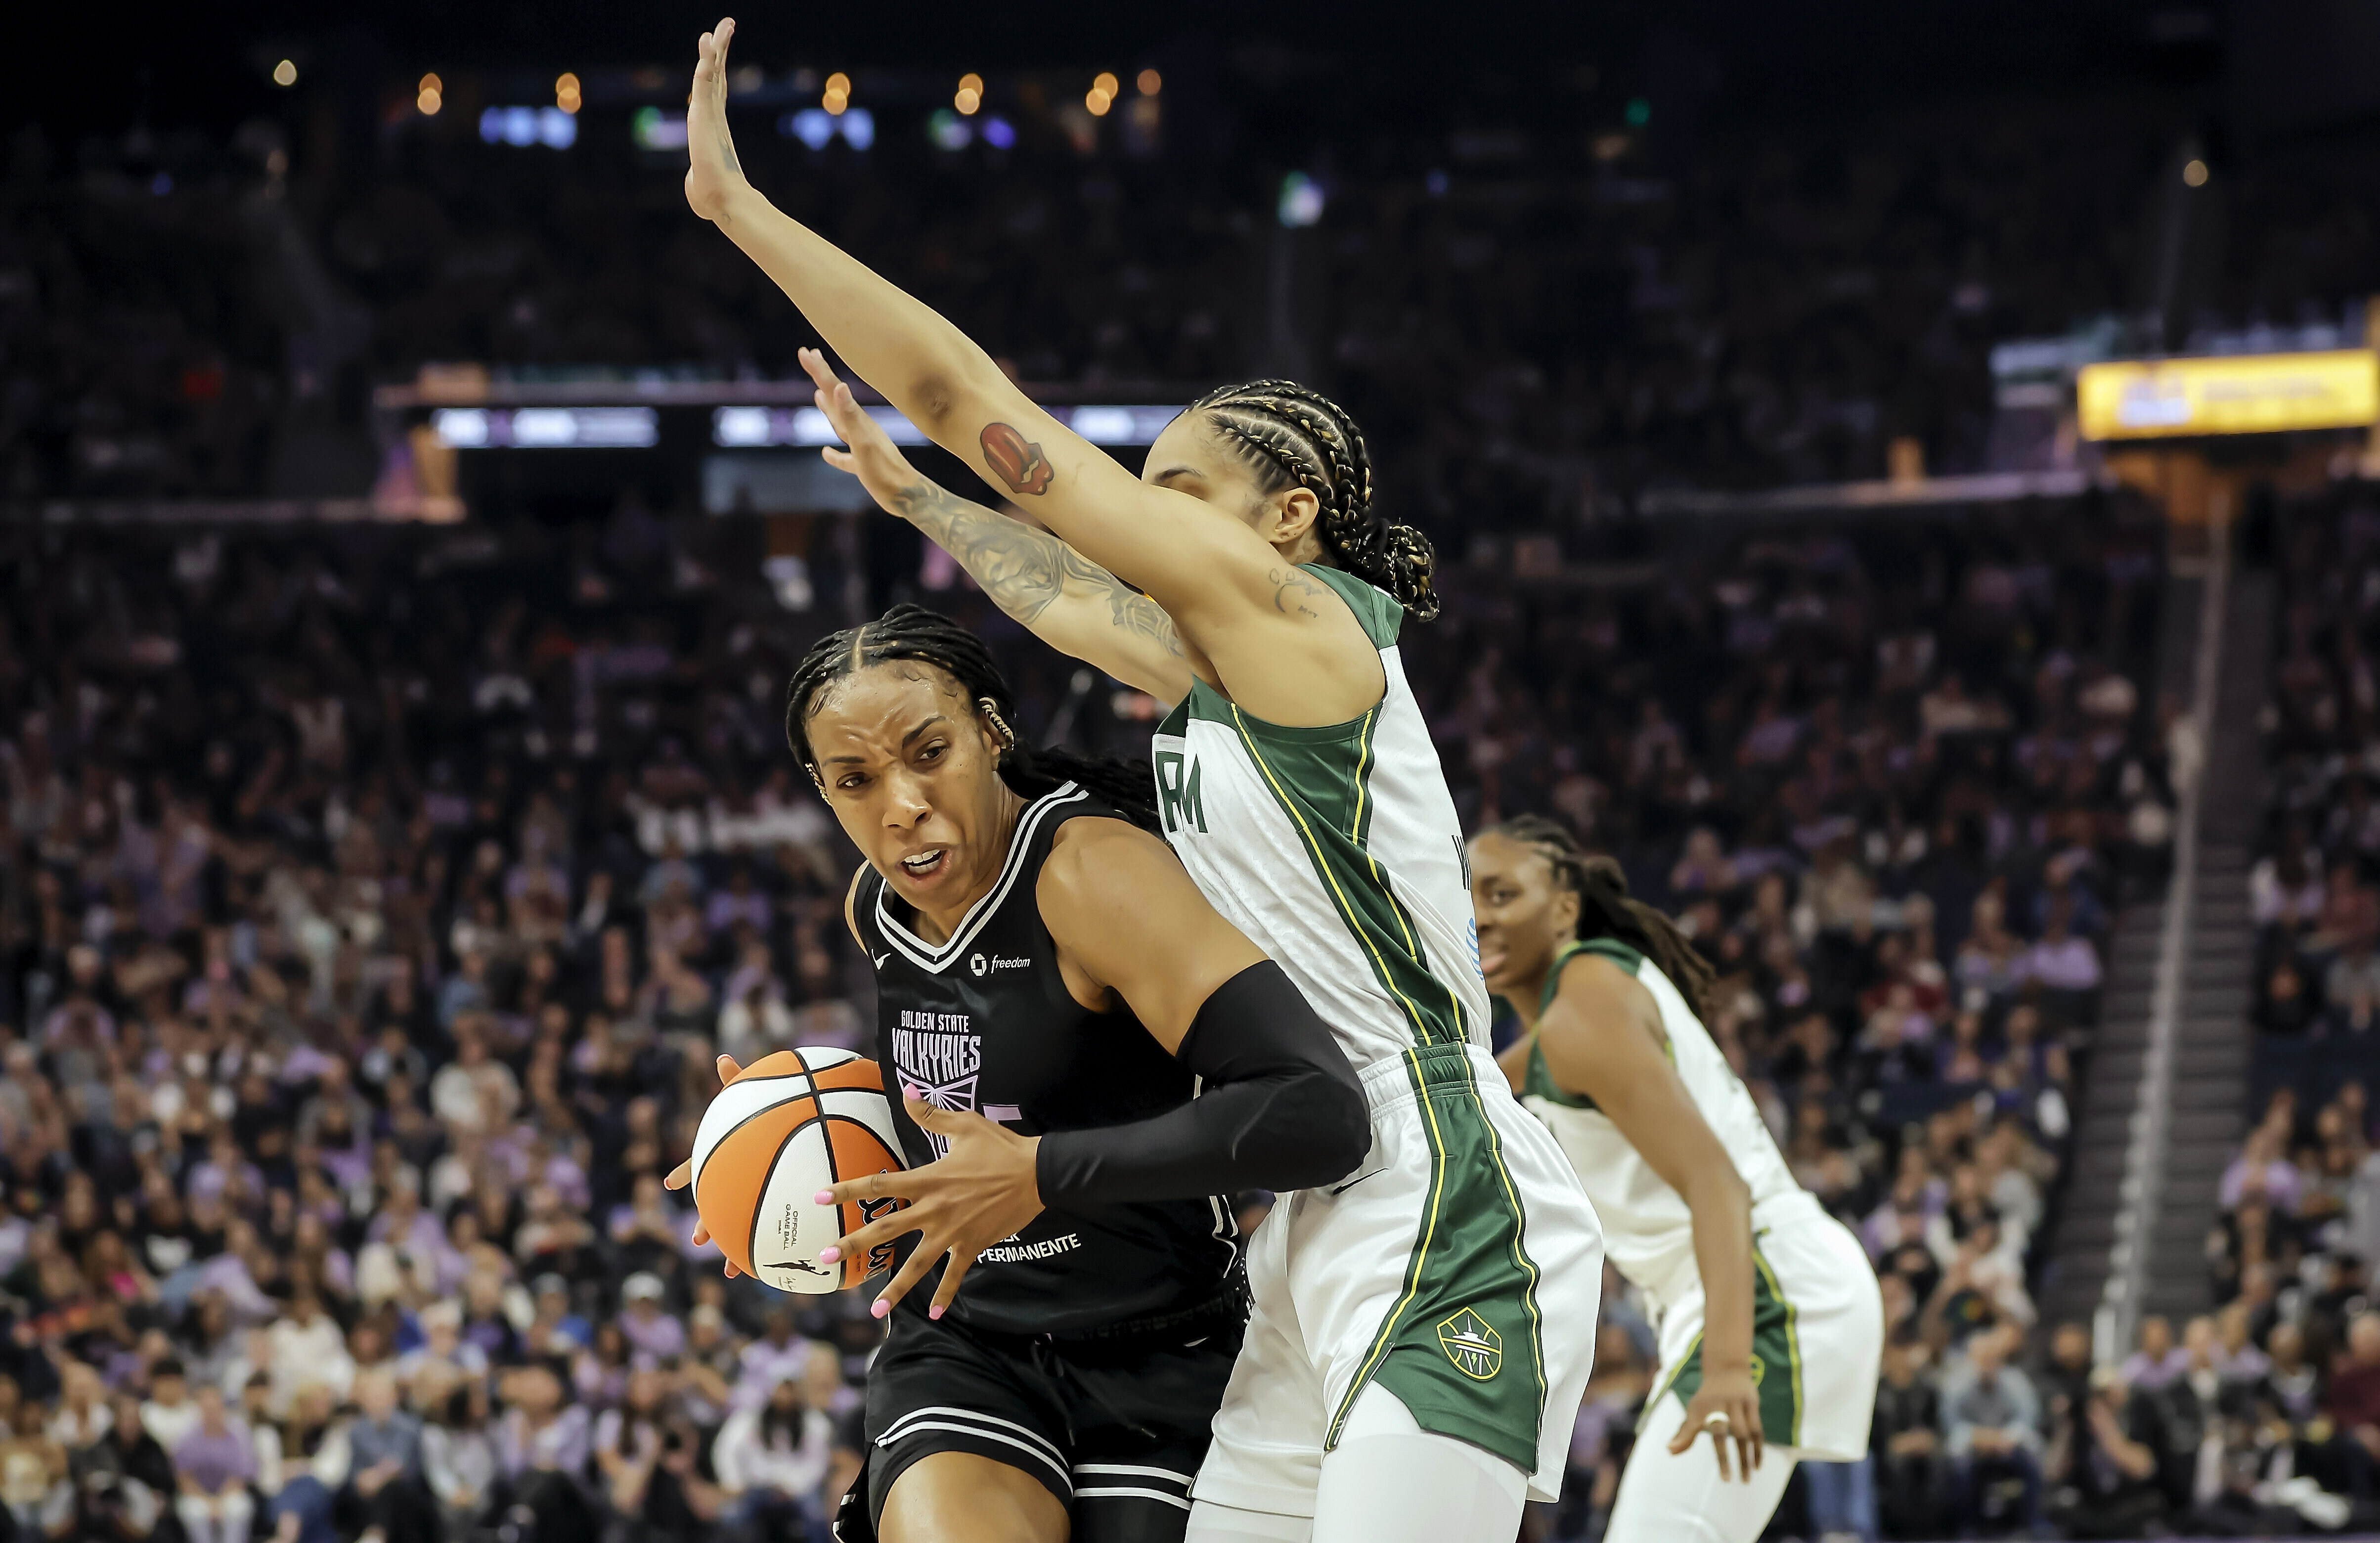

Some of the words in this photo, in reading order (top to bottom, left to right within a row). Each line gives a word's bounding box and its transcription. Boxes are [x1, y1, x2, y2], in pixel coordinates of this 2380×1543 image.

[991, 954, 1030, 974] freedom
[901, 1010, 935, 1031] GOLDEN
[938, 1014, 969, 1033] STATE
[892, 1027, 981, 1084] VALKYRIES
